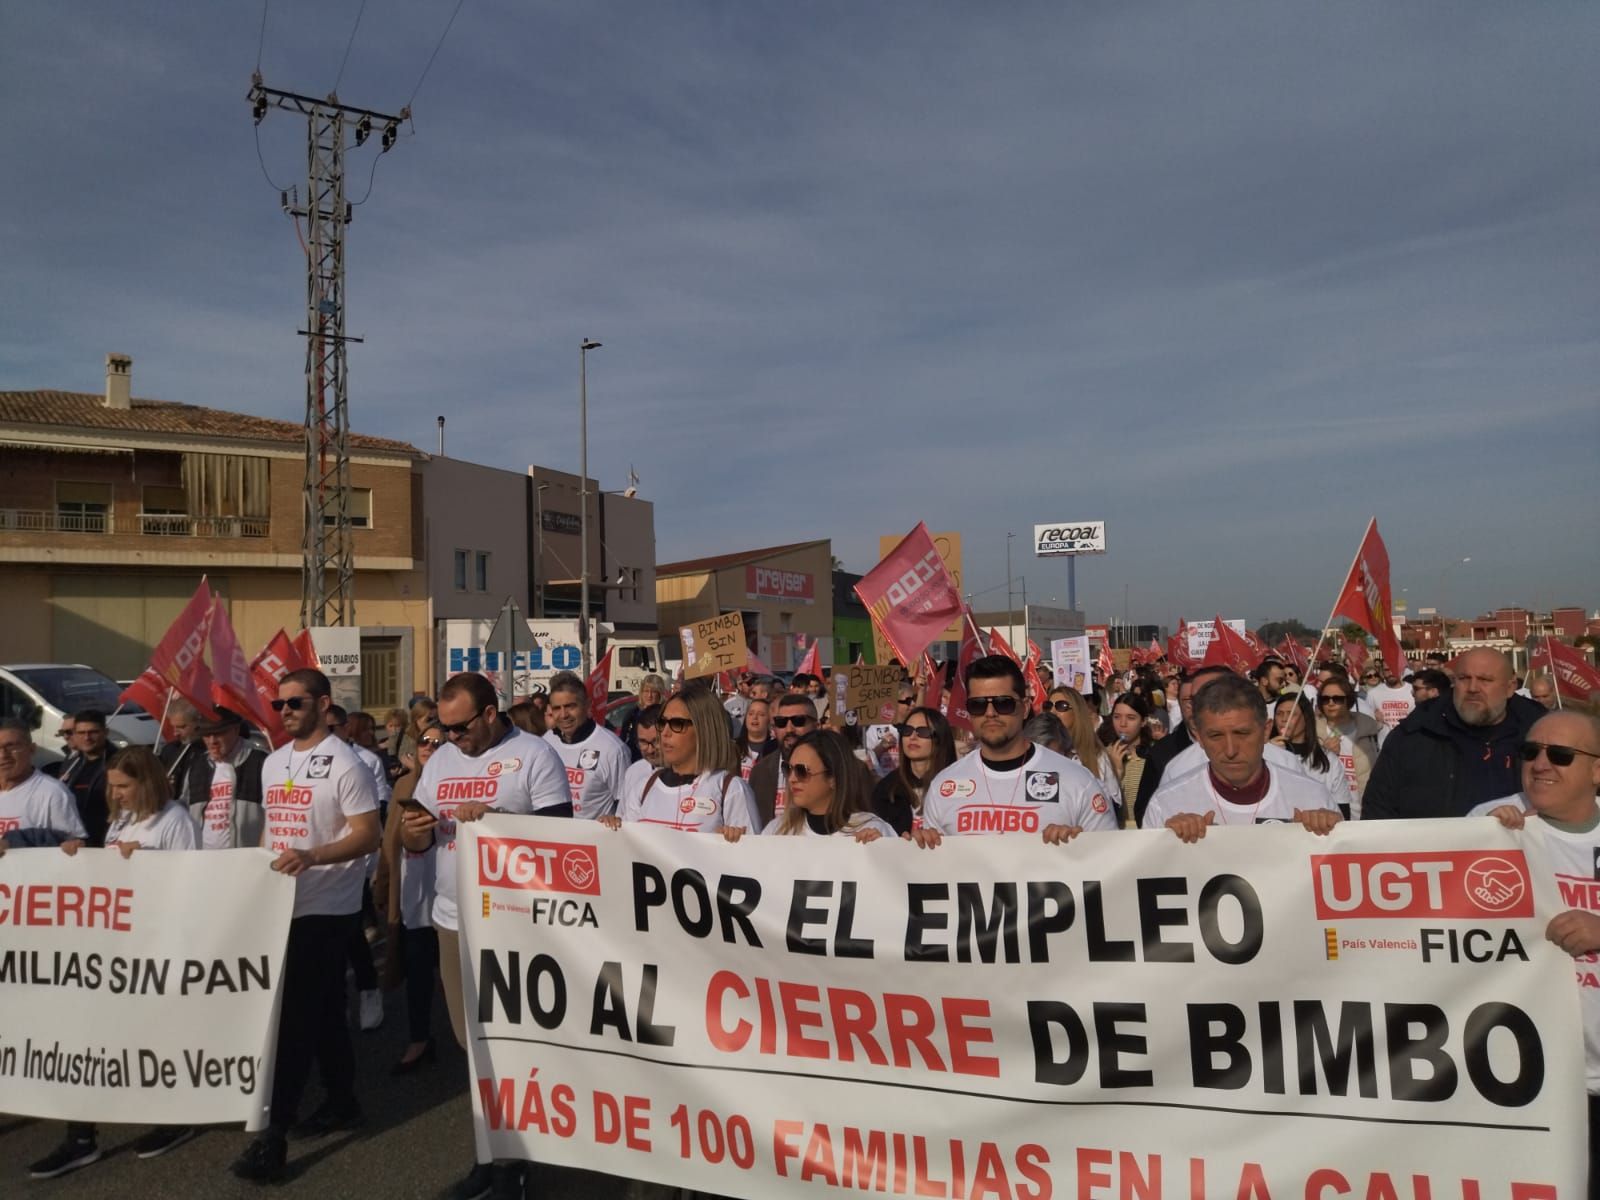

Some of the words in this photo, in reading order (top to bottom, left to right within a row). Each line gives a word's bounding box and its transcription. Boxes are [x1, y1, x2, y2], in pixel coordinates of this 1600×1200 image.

[1039, 526, 1099, 542] recoal
[698, 614, 740, 639] BIMBO
[708, 632, 736, 650] SIN
[333, 654, 359, 665] DIARIOS
[450, 646, 582, 671] HIELO
[715, 653, 734, 666] TI
[850, 667, 900, 688] BIMBO
[858, 687, 892, 702] SENSE
[854, 705, 878, 720] TU
[266, 788, 313, 805] BIMBO
[437, 779, 498, 801] BIMBO
[957, 810, 1039, 833] BIMBO
[481, 843, 557, 885] UGT
[1319, 860, 1454, 912] UGT
[532, 897, 599, 929] FICA
[631, 861, 763, 949] POR
[786, 879, 875, 959] EL
[904, 873, 1264, 965] EMPLEO
[1342, 939, 1367, 950] País
[1368, 939, 1417, 950] Valencià
[1420, 928, 1531, 963] FICA
[109, 956, 170, 996] SIN
[180, 954, 271, 996] PAN
[478, 948, 567, 1031] NO
[589, 960, 676, 1047] AL
[705, 970, 1000, 1079] CIERRE
[1026, 1000, 1154, 1089] DE
[1187, 1000, 1545, 1108] BIMBO
[23, 1038, 130, 1088] Industrial
[138, 1048, 177, 1089] De
[183, 1048, 261, 1095] Verg
[477, 1067, 577, 1138] MÁS
[592, 1090, 652, 1153] DE
[670, 1103, 756, 1171] 100
[773, 1119, 1053, 1200] FAMILIAS
[1076, 1147, 1162, 1200] EN
